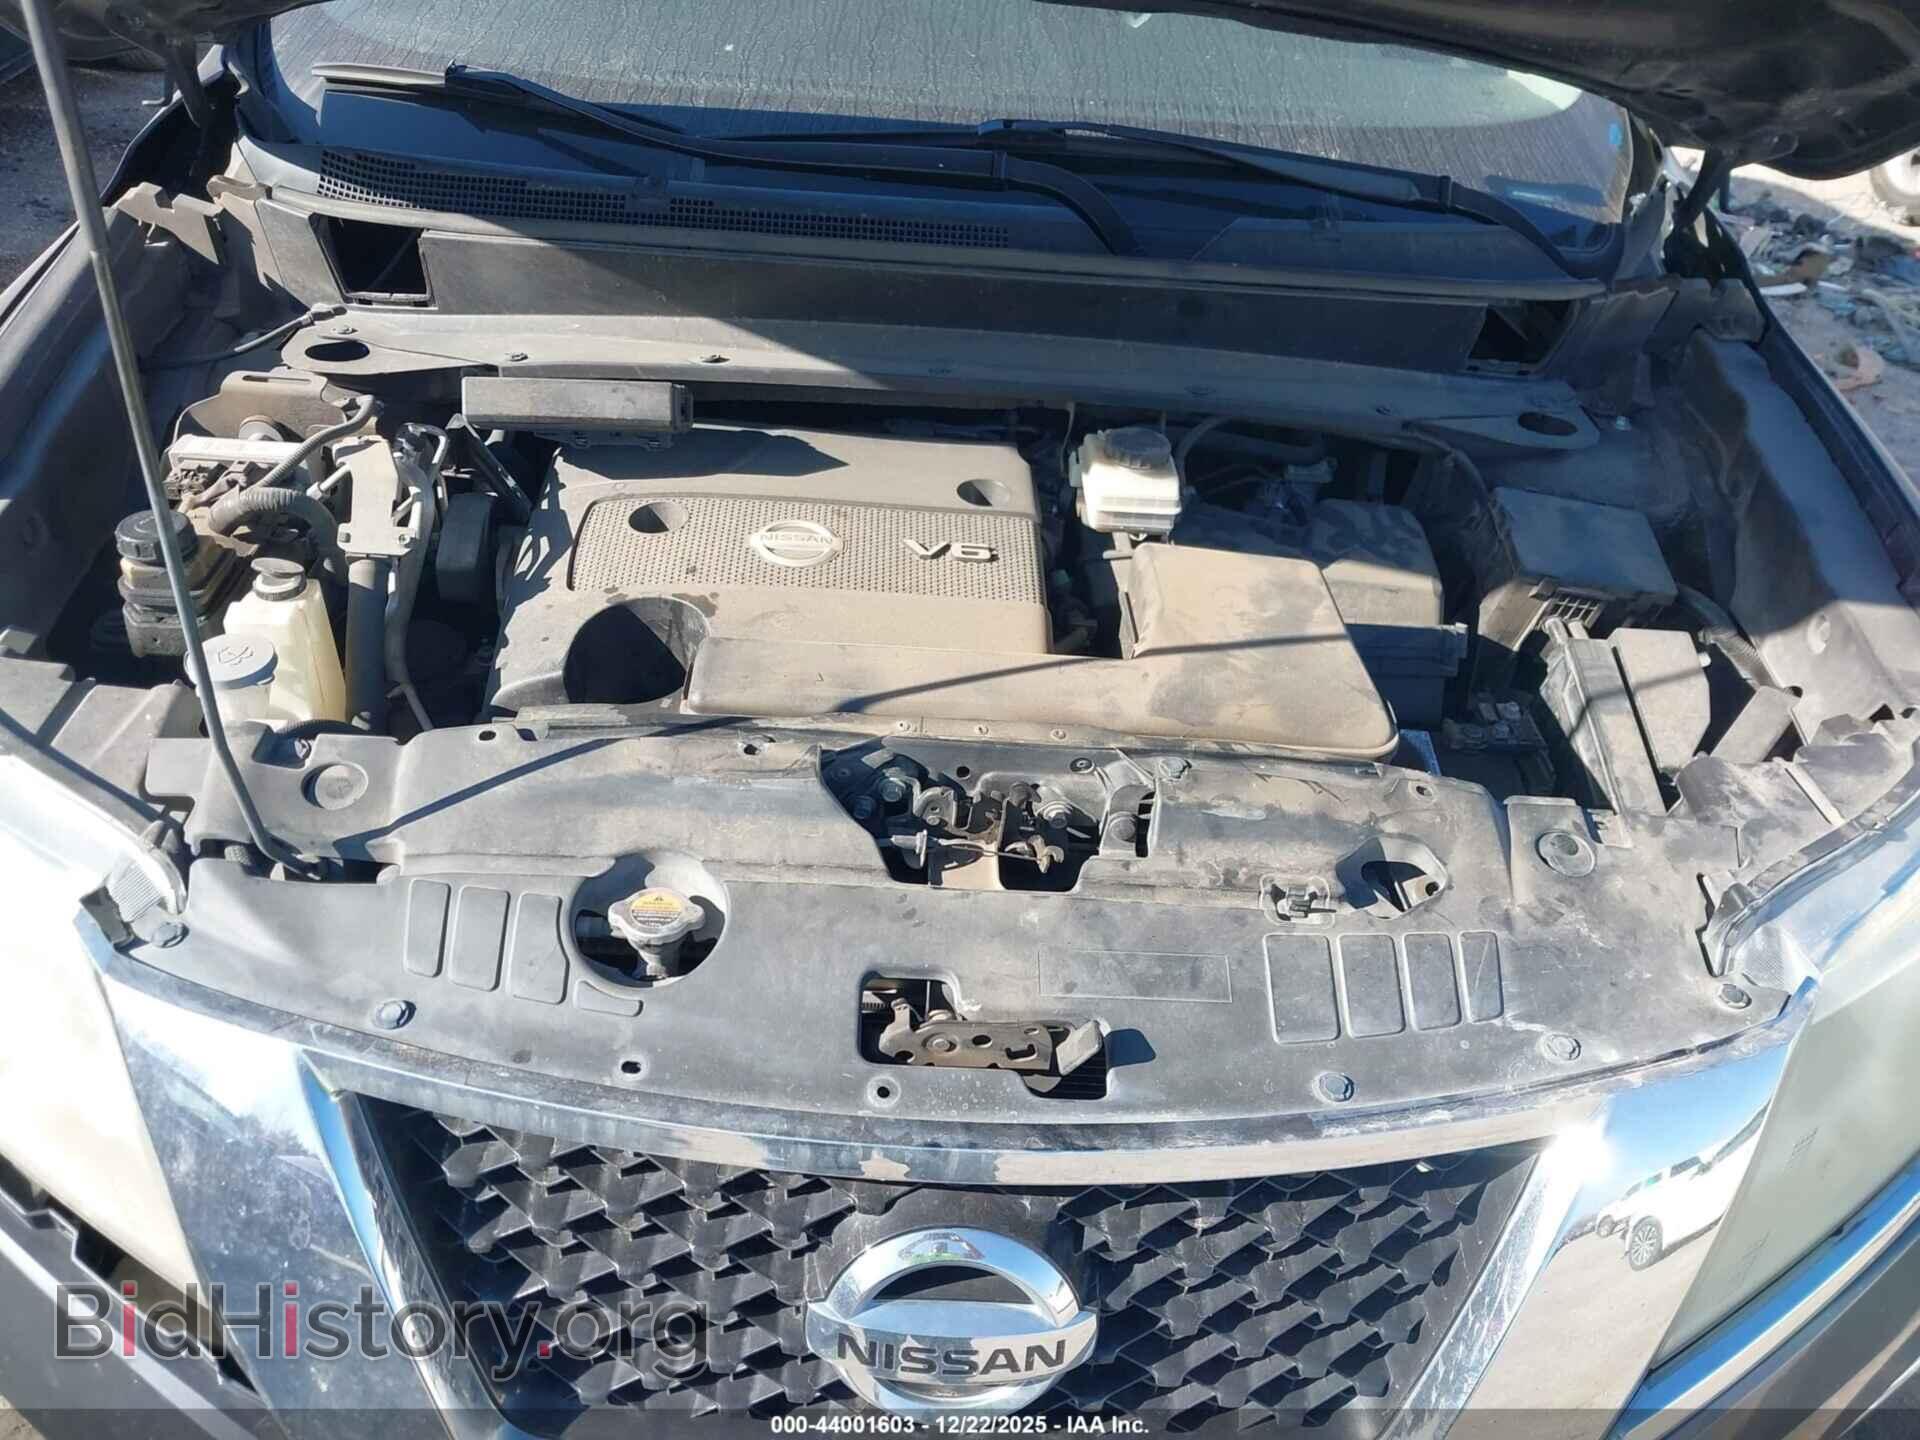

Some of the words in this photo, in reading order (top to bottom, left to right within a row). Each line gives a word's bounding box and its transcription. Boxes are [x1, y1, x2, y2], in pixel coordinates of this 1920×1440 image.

[760, 533, 833, 545] NISSAN
[903, 538, 997, 562] V6
[836, 1333, 1067, 1376] NISSAN
